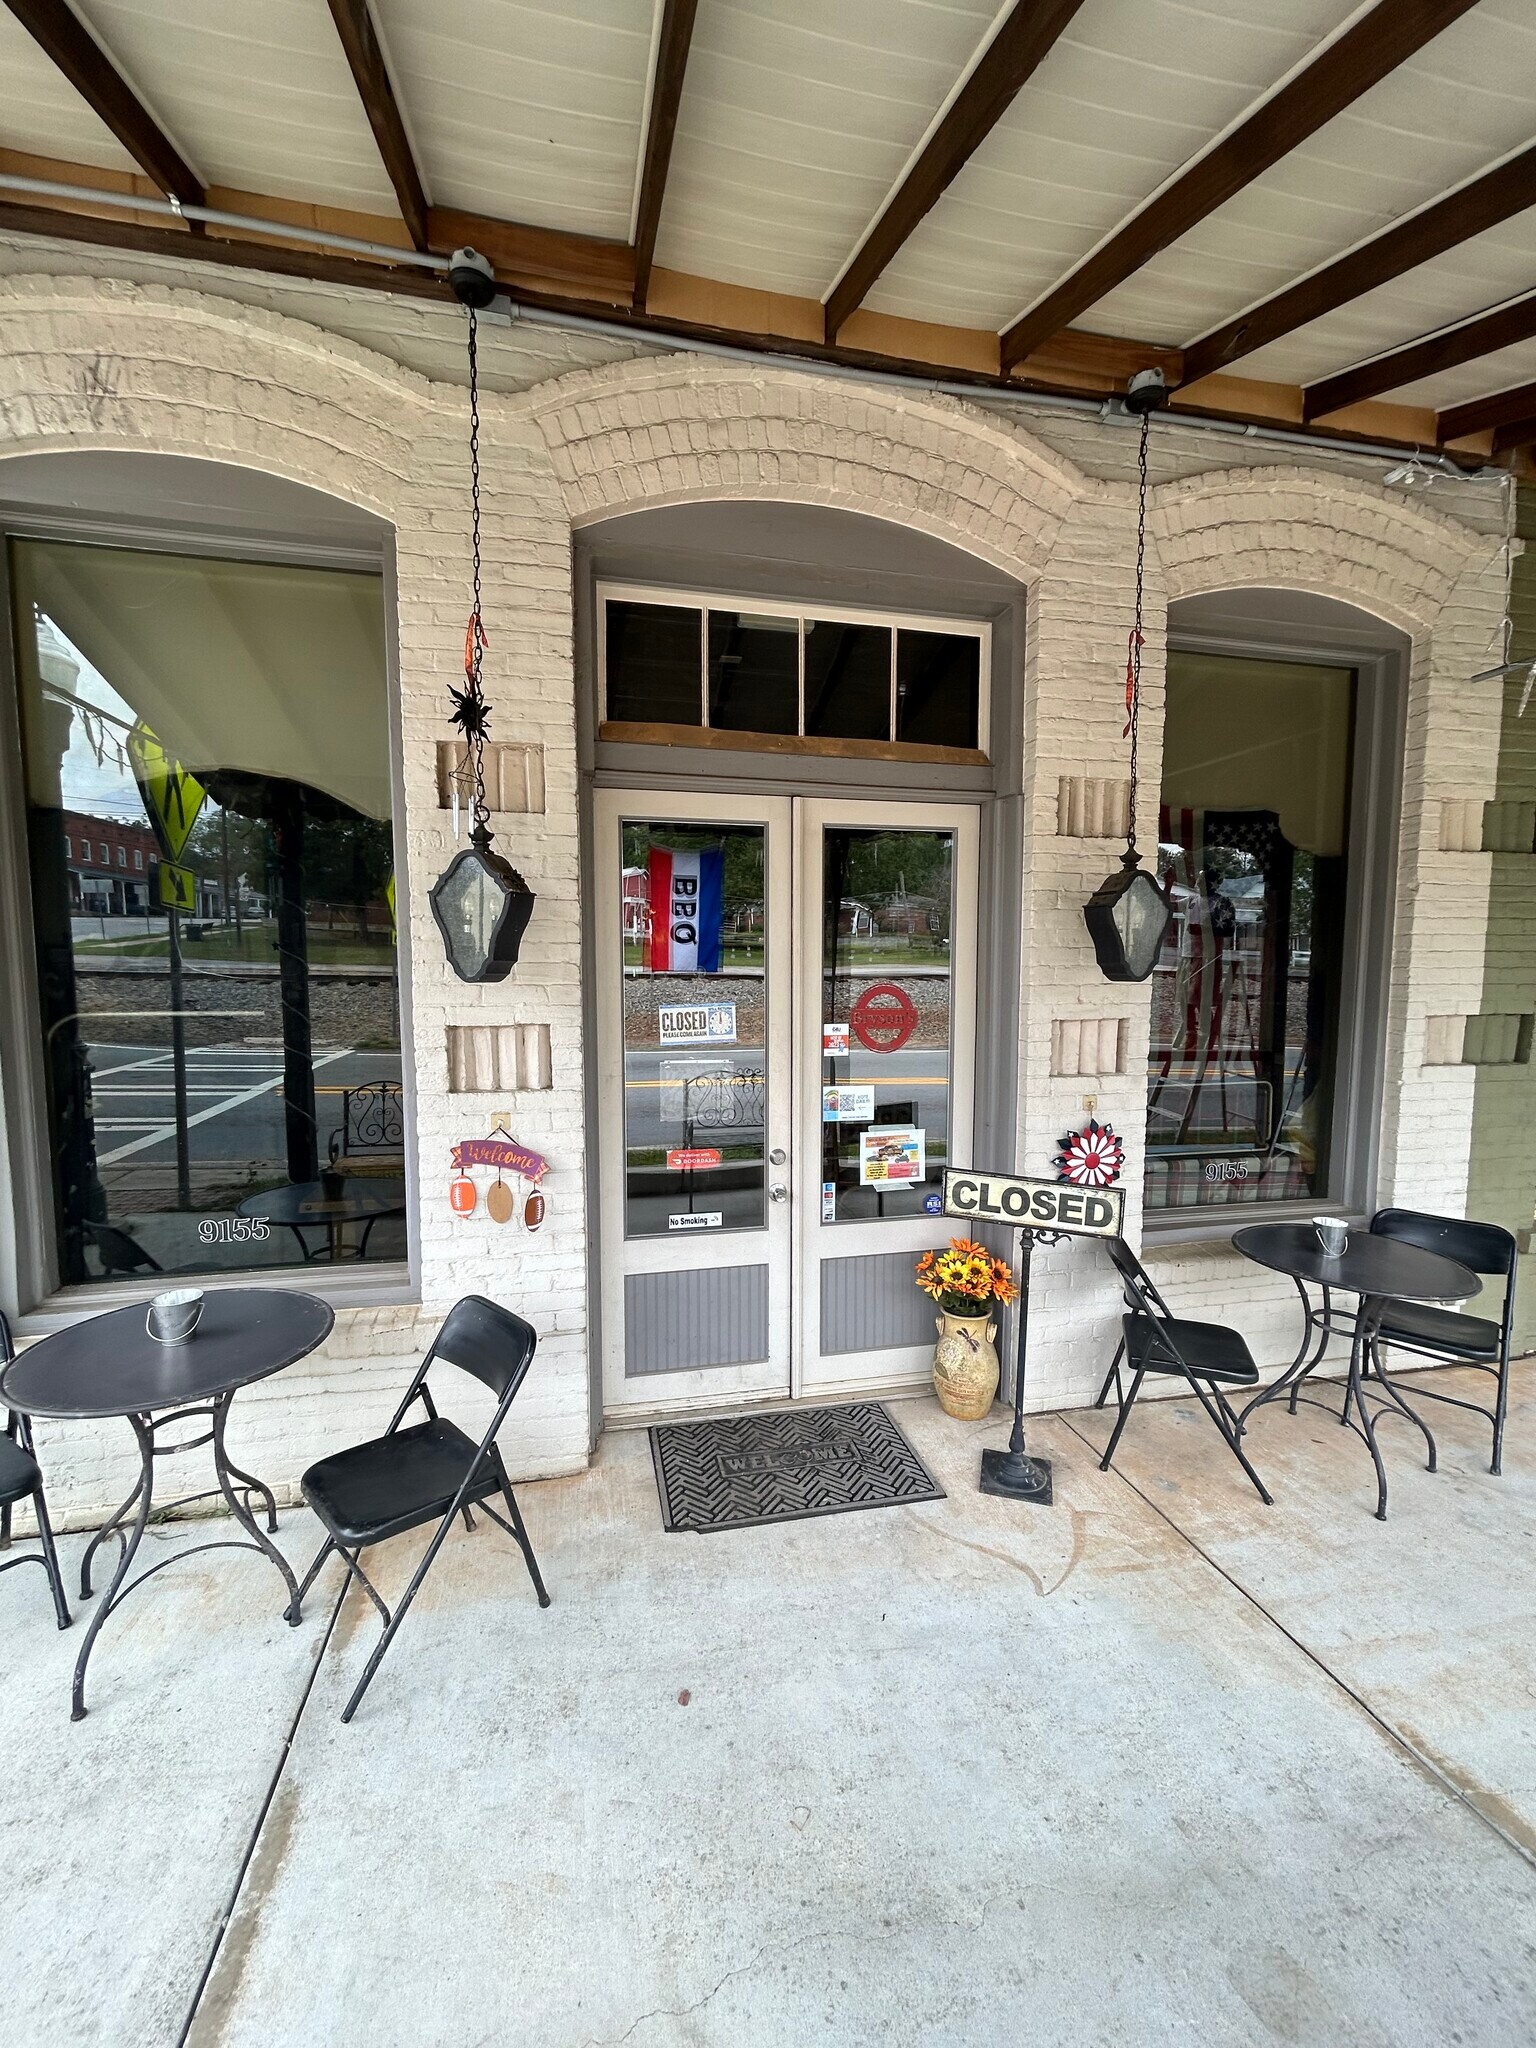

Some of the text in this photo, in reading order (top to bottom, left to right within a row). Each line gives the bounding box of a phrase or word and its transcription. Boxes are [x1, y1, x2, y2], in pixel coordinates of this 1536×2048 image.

[670, 874, 698, 946] BBQ
[662, 1011, 707, 1031] CLOSED
[1205, 1161, 1249, 1182] 9155
[951, 1180, 1114, 1228] CLOSED
[198, 1216, 271, 1244] 9155
[680, 1216, 708, 1225] Smoking
[727, 1445, 851, 1470] WELCOME
